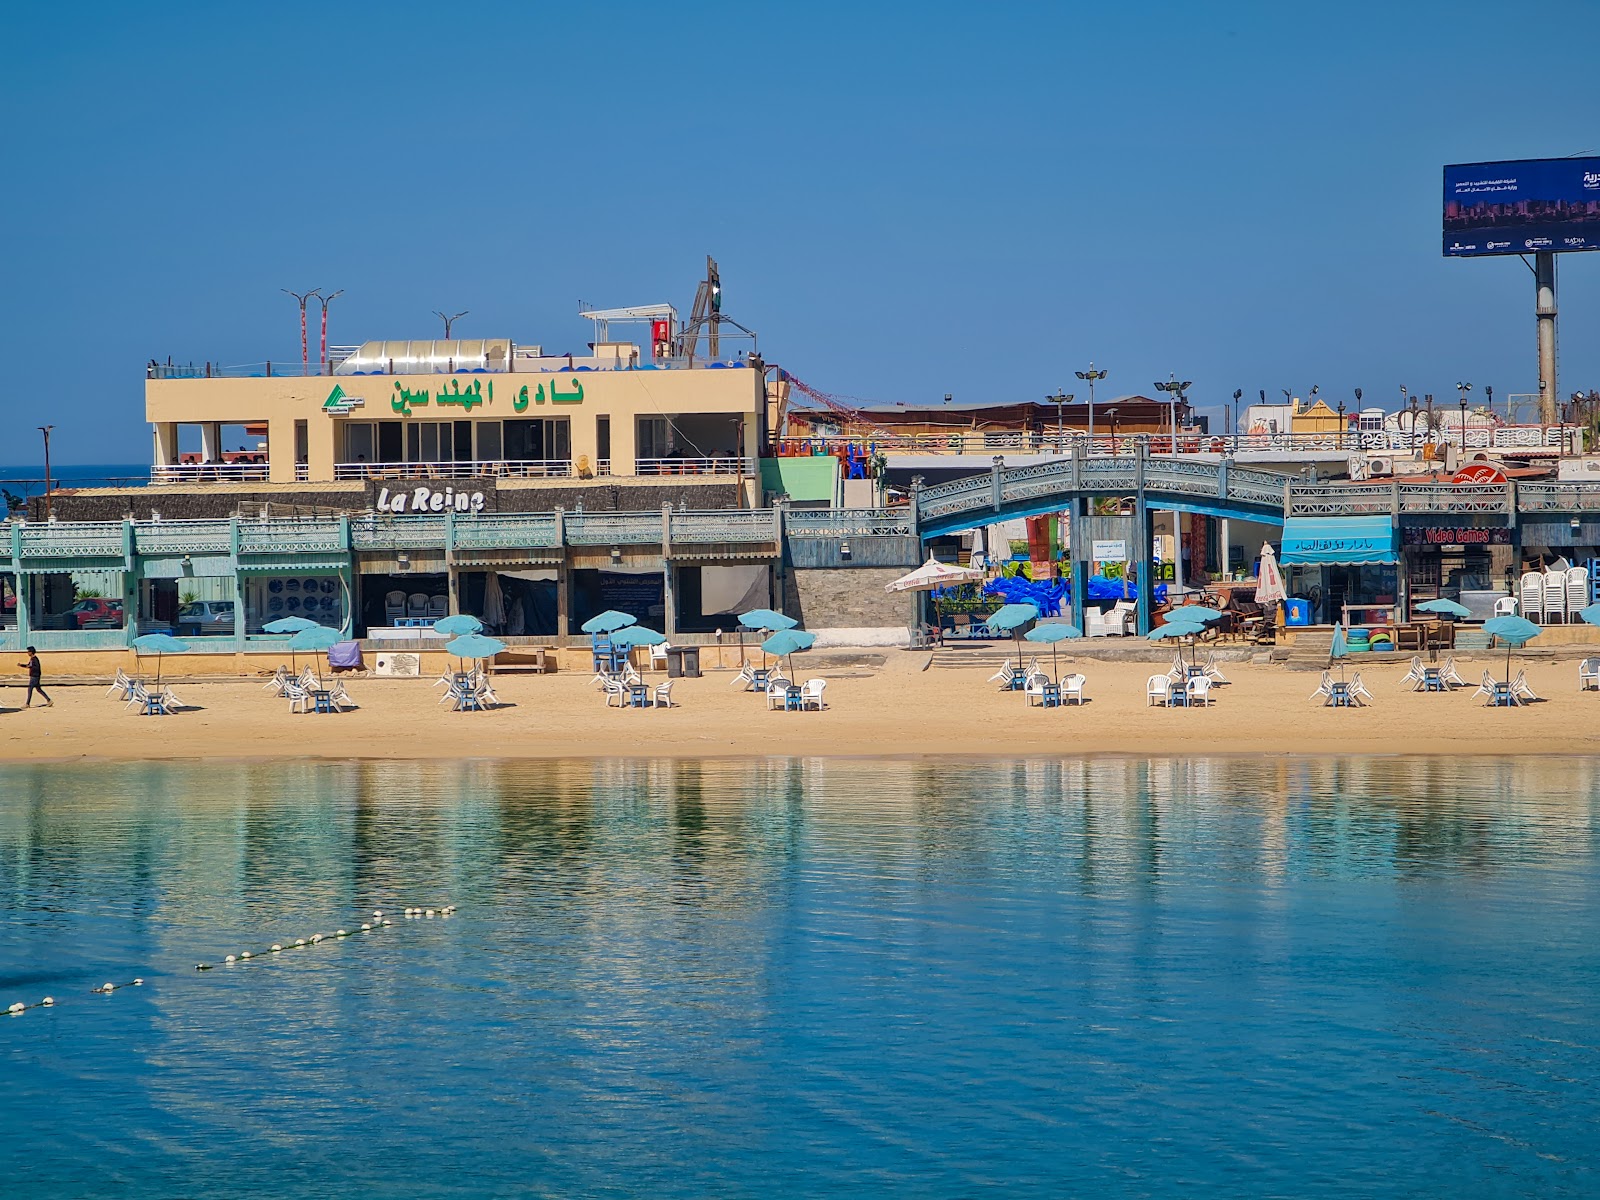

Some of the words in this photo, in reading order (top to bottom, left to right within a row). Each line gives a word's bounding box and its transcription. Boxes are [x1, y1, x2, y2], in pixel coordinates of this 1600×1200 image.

[391, 378, 493, 414] المهندسين
[377, 487, 407, 513] La
[411, 486, 485, 513] Reine
[1426, 528, 1454, 544] Video
[1456, 528, 1490, 544] Games
